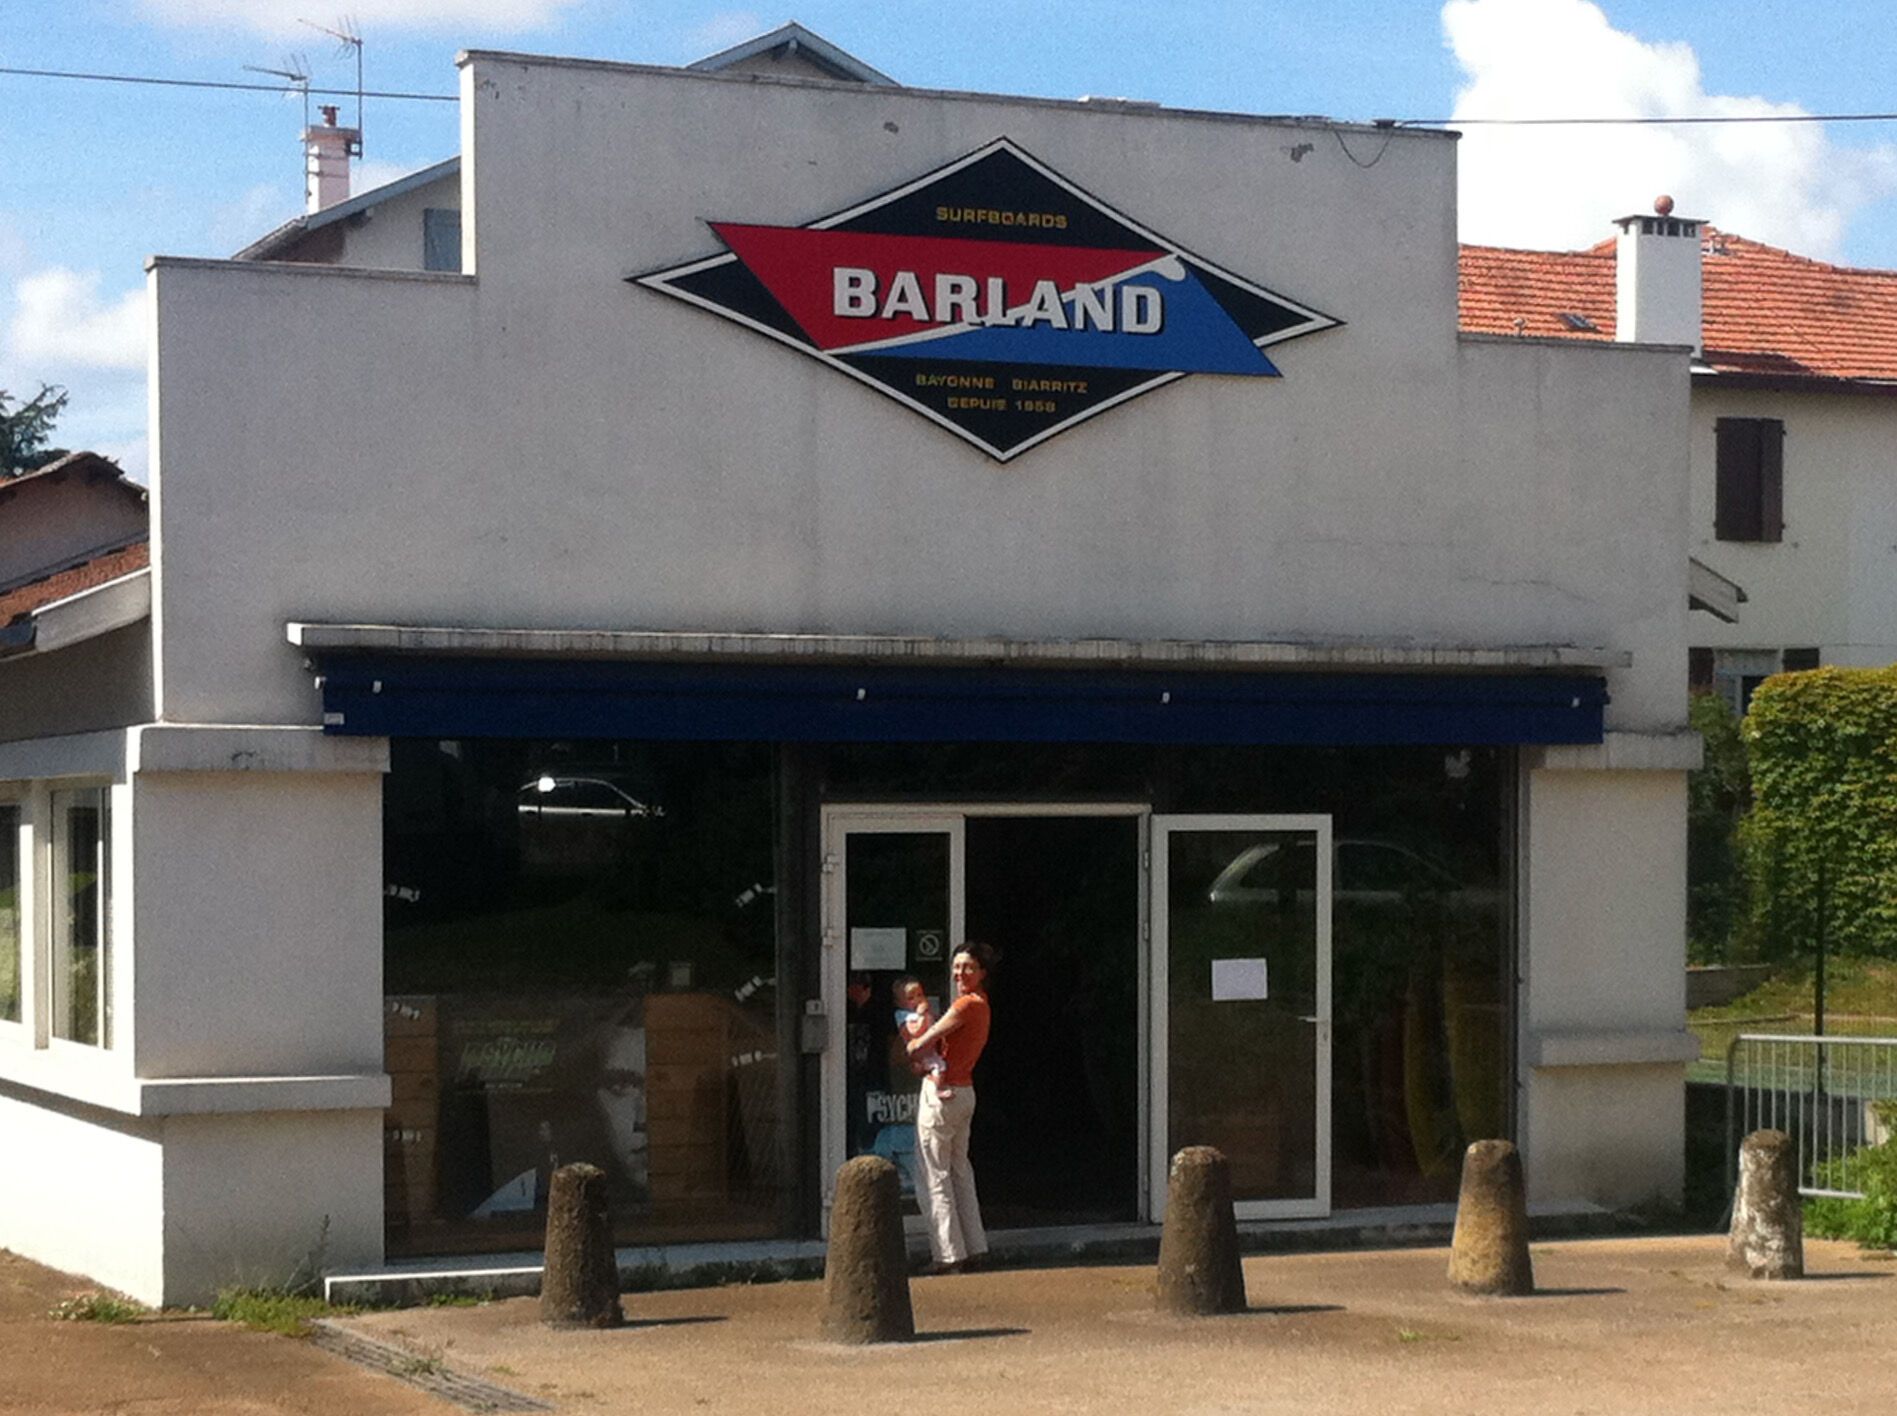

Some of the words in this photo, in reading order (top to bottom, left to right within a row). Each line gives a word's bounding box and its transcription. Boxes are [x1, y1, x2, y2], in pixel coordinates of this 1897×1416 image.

[935, 206, 1068, 229] SURFBOARDS
[833, 267, 1162, 334] BARLAND
[915, 374, 996, 389] BAYONNE
[1012, 379, 1088, 393] BIARRITZ
[947, 397, 1007, 410] DEPUIS
